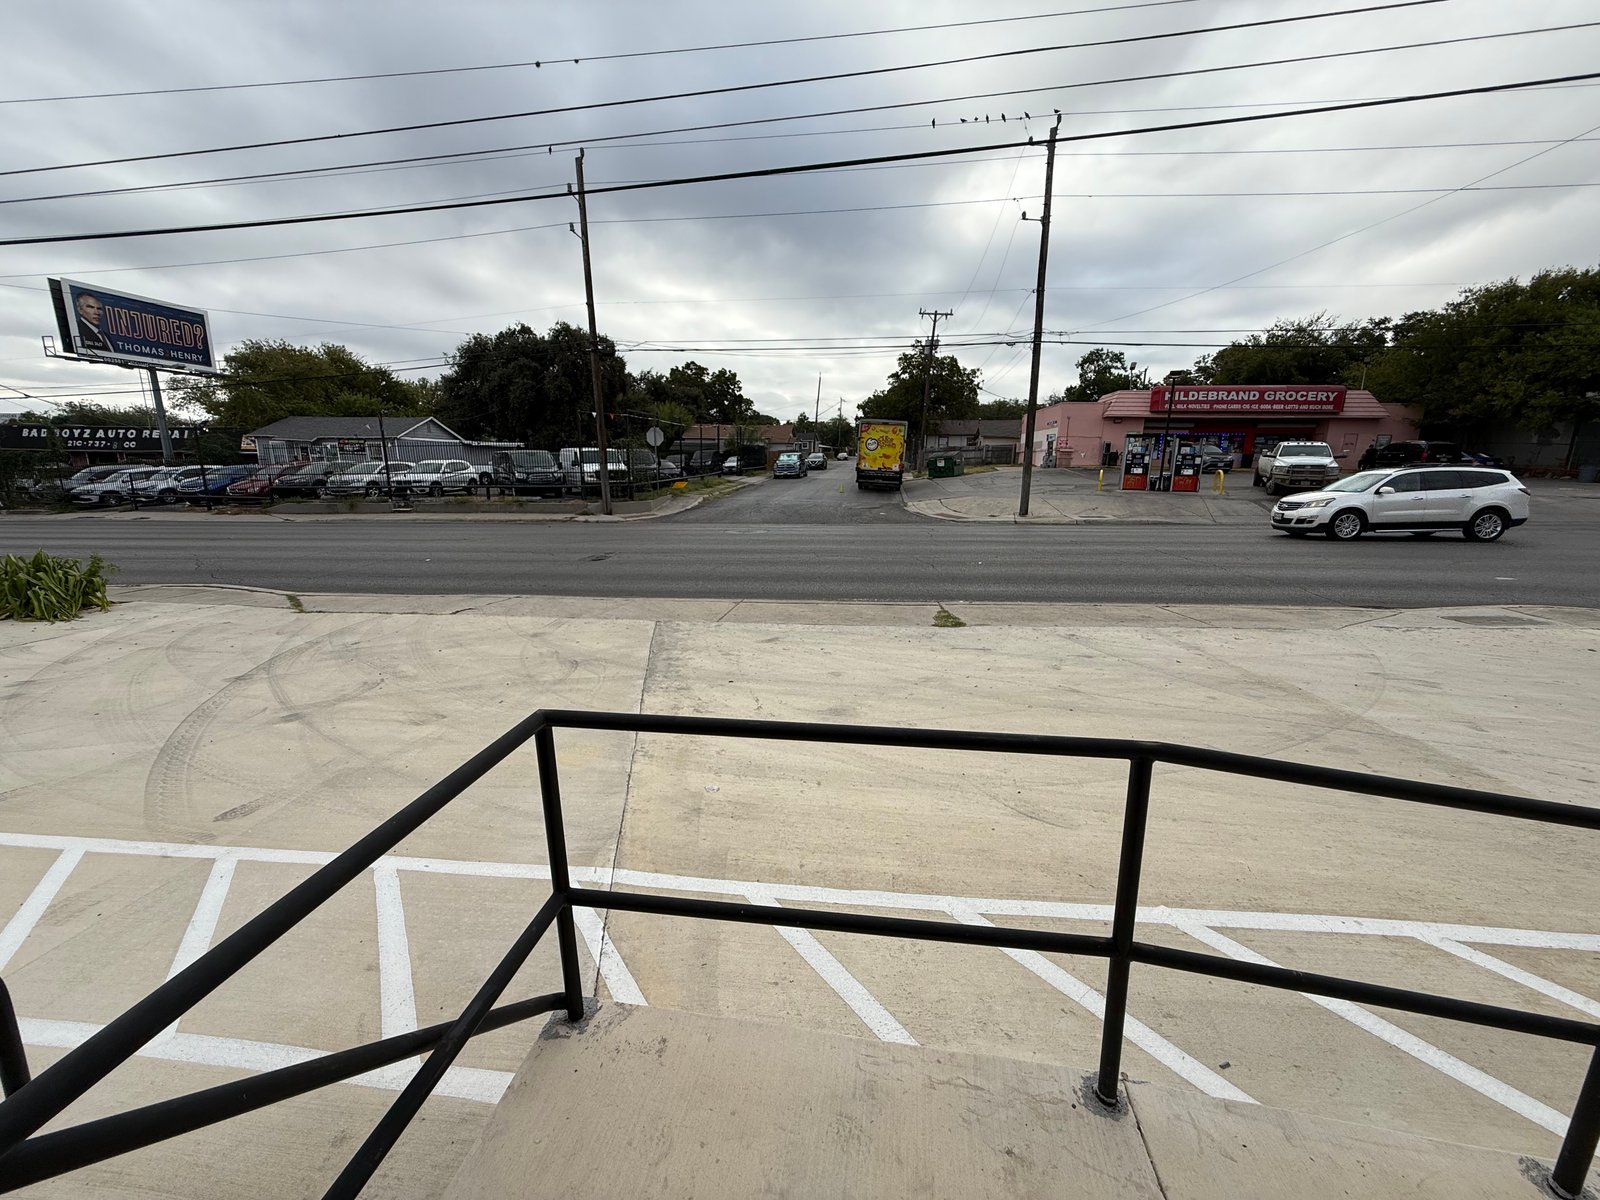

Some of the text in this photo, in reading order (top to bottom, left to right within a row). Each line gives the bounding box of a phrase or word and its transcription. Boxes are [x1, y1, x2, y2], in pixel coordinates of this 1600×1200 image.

[105, 306, 204, 349] INJURED?
[116, 341, 203, 362] THOMAS HENRY
[1165, 392, 1338, 401] HILDEBRAND GROCERY
[22, 428, 48, 437] BAD
[95, 429, 136, 438] AUTO
[142, 430, 200, 438] REAI
